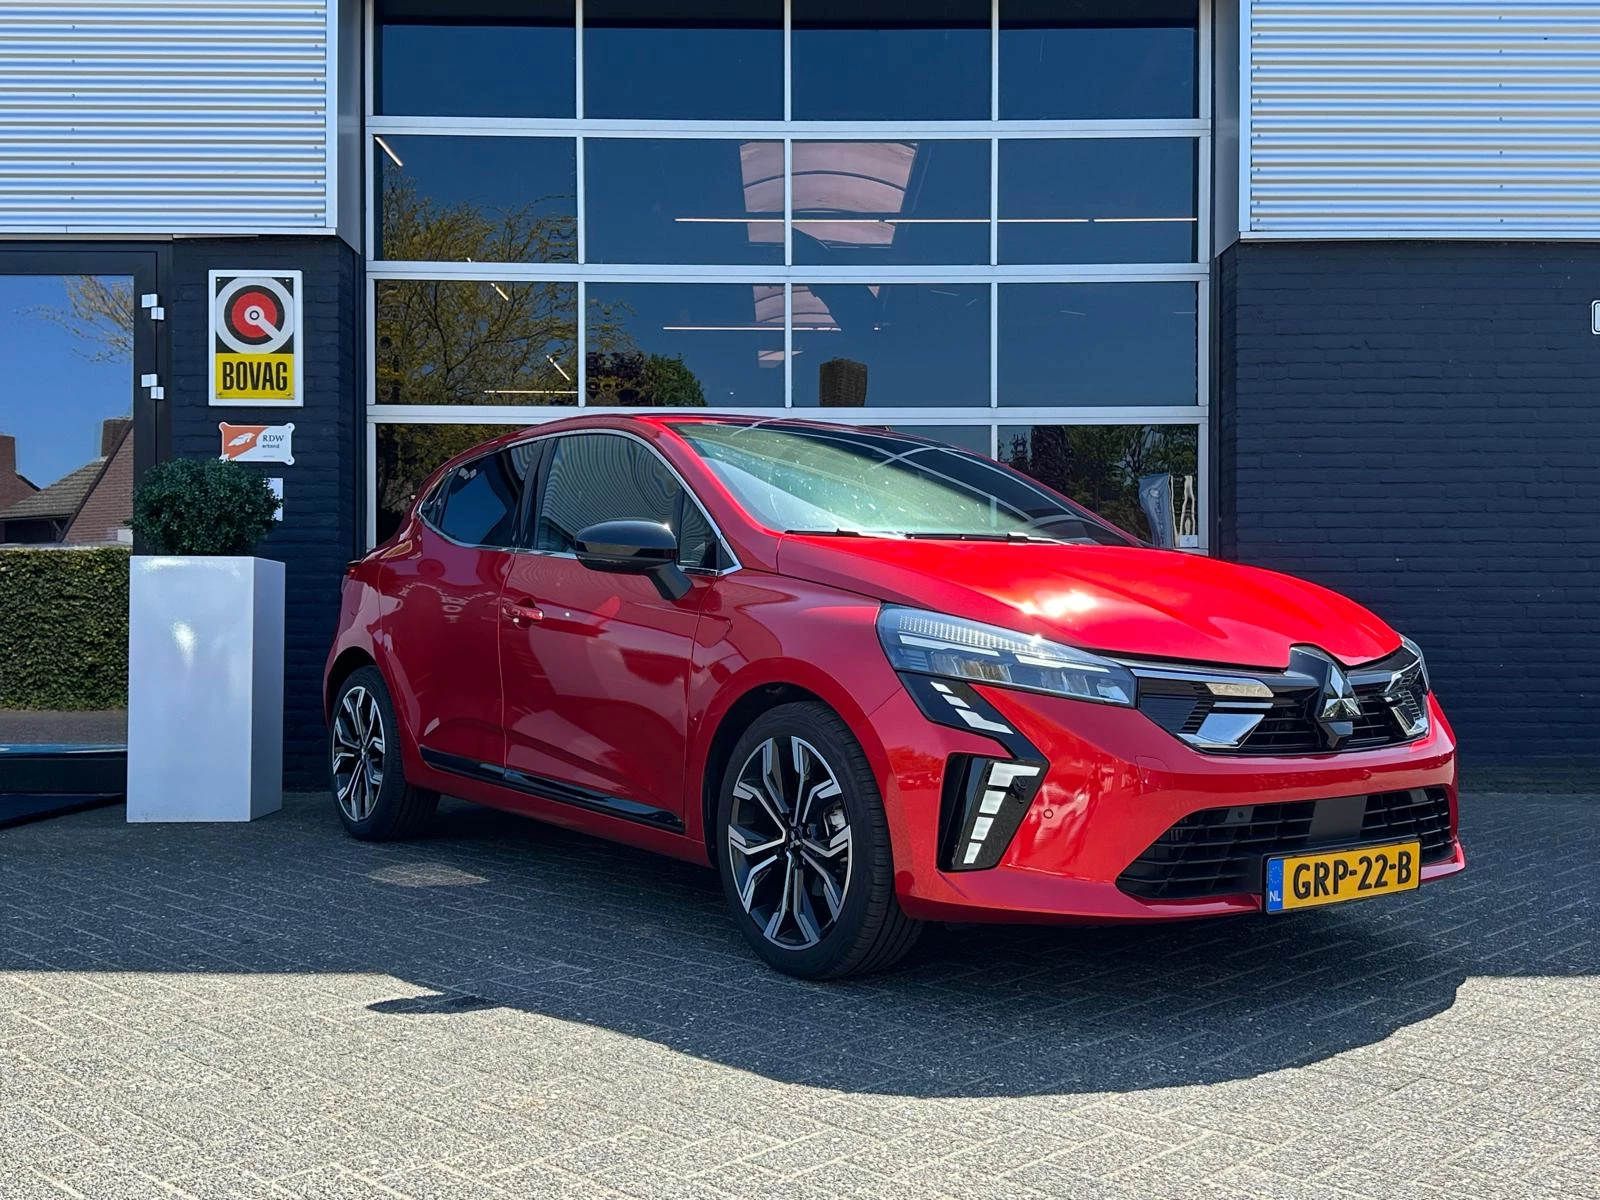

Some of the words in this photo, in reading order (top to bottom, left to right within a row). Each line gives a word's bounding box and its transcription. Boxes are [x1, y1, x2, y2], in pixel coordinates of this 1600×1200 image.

[222, 361, 288, 391] BOVAG
[262, 434, 285, 442] RDW
[1293, 850, 1412, 900] GRP-22-B
[1269, 890, 1281, 902] NL
